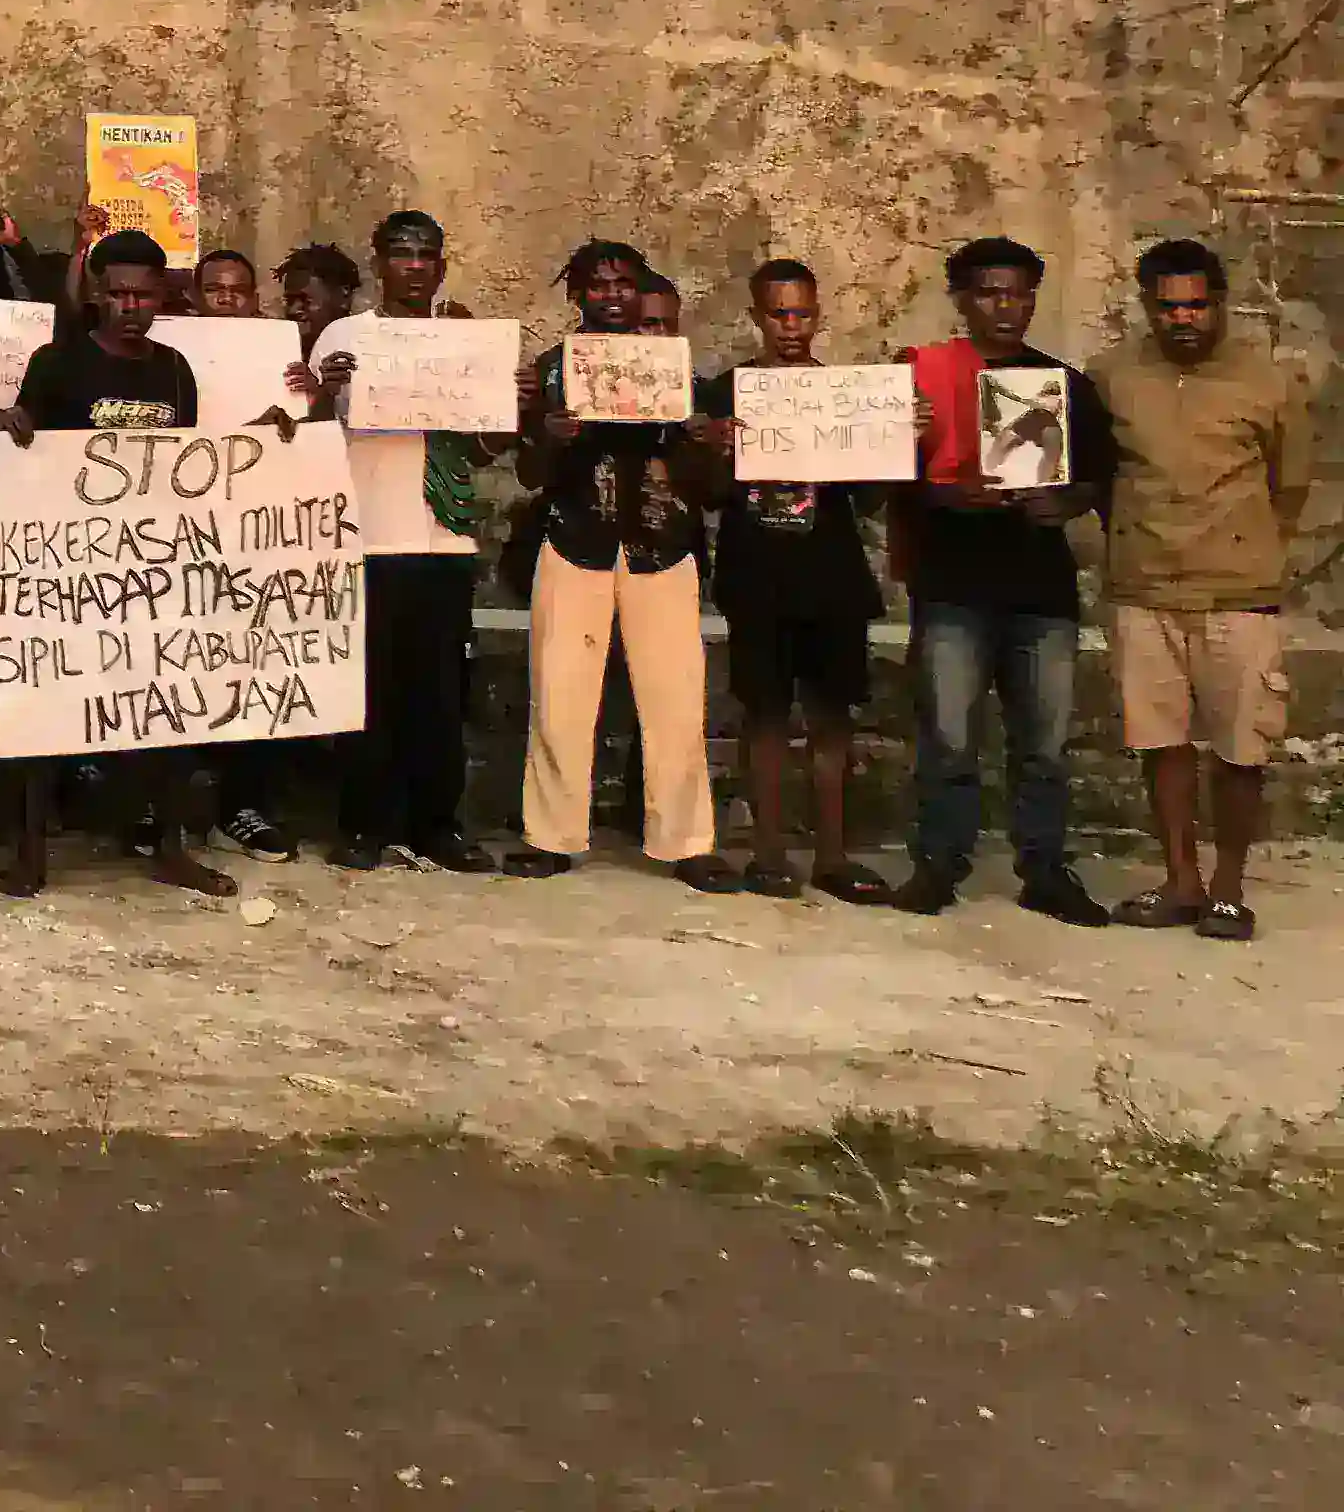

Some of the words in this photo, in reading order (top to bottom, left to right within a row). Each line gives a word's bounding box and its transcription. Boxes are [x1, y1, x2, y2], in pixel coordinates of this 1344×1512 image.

[101, 126, 173, 145] HENTIKAN
[73, 431, 265, 506] STOP
[740, 426, 797, 457] POS
[0, 509, 224, 571] KEKERASAN
[239, 492, 361, 552] MILITER
[96, 629, 133, 673] DI
[152, 625, 352, 676] KABUPATEN
[83, 676, 209, 744] INTAN
[208, 672, 319, 736] JAYA
